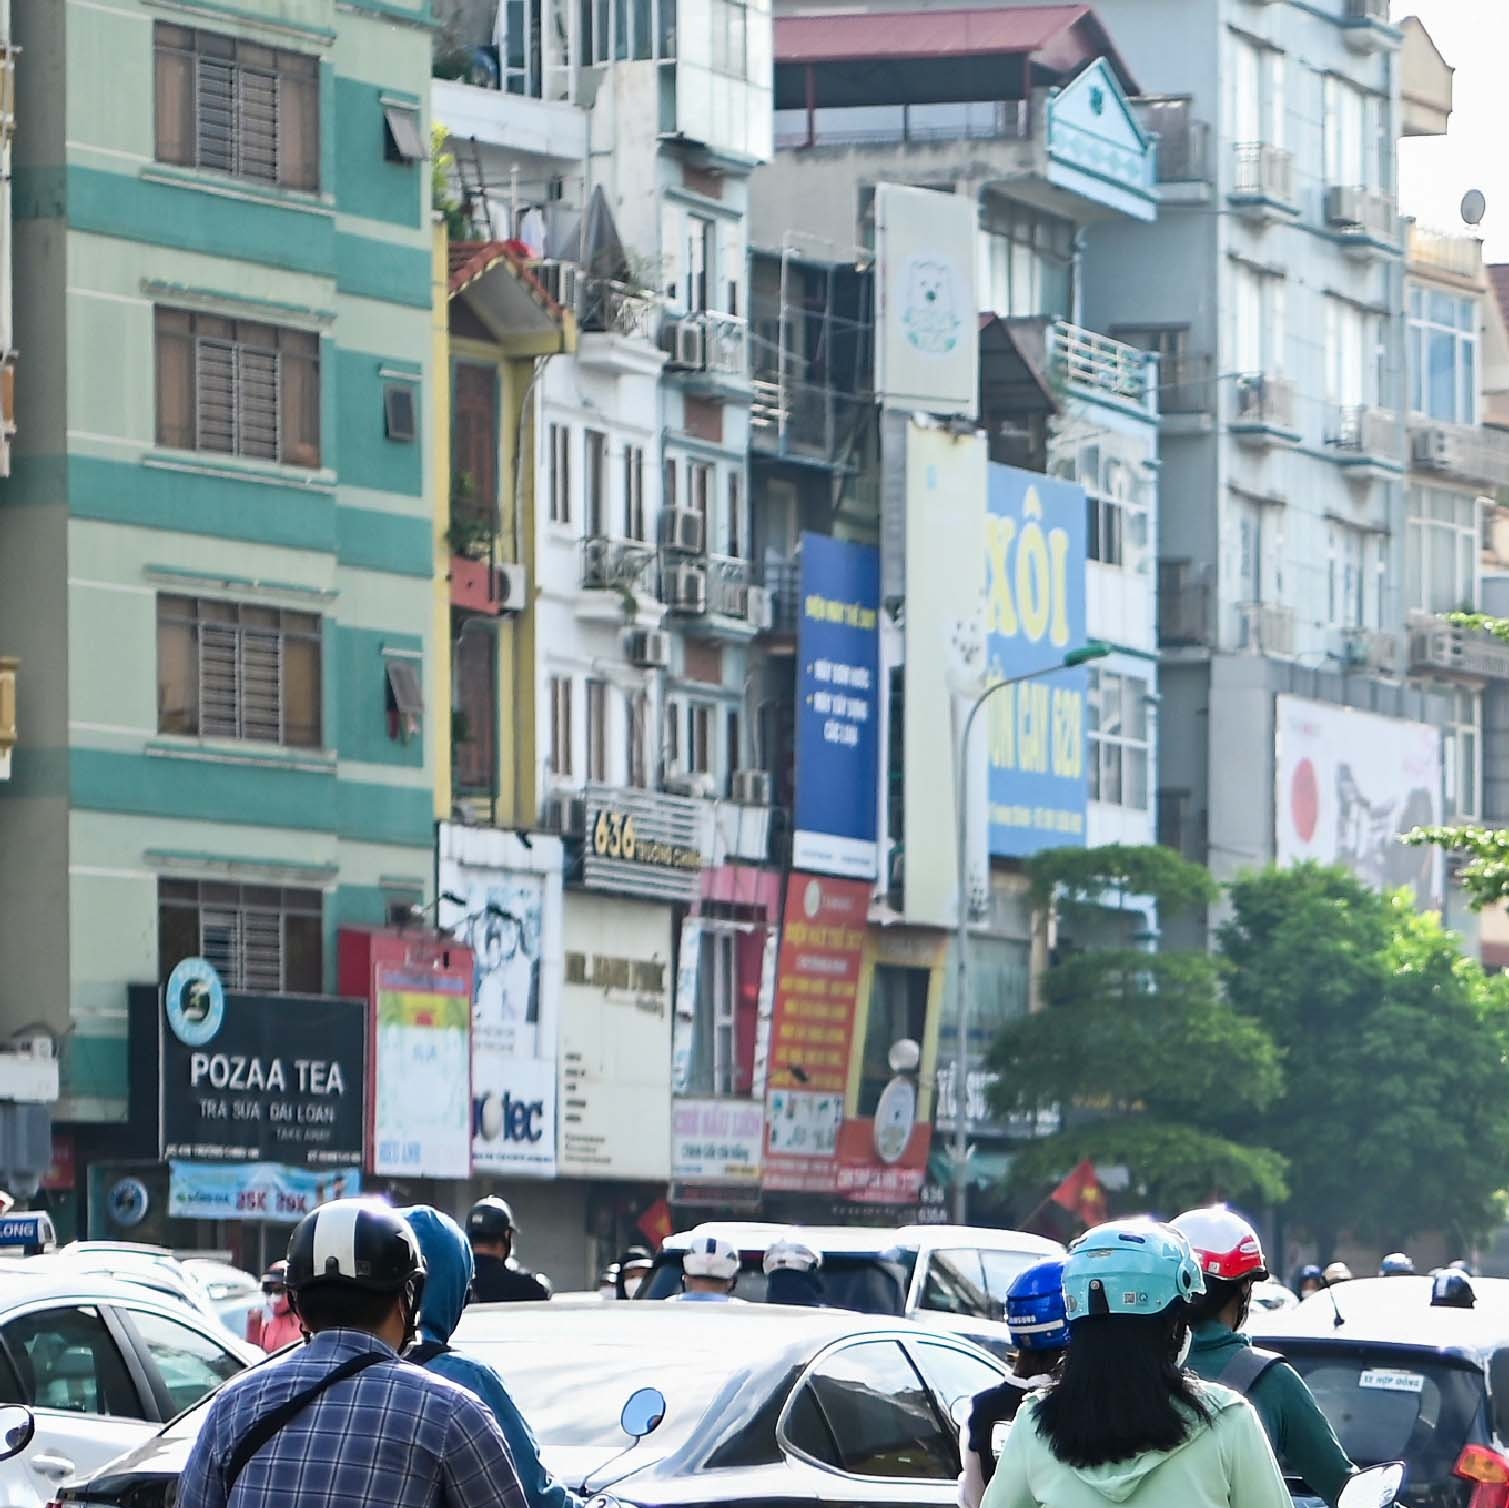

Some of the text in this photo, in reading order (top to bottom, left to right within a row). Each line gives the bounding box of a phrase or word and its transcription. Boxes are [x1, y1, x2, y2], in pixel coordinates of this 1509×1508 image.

[593, 808, 636, 860] 636
[190, 1052, 345, 1095] POZAA TEA
